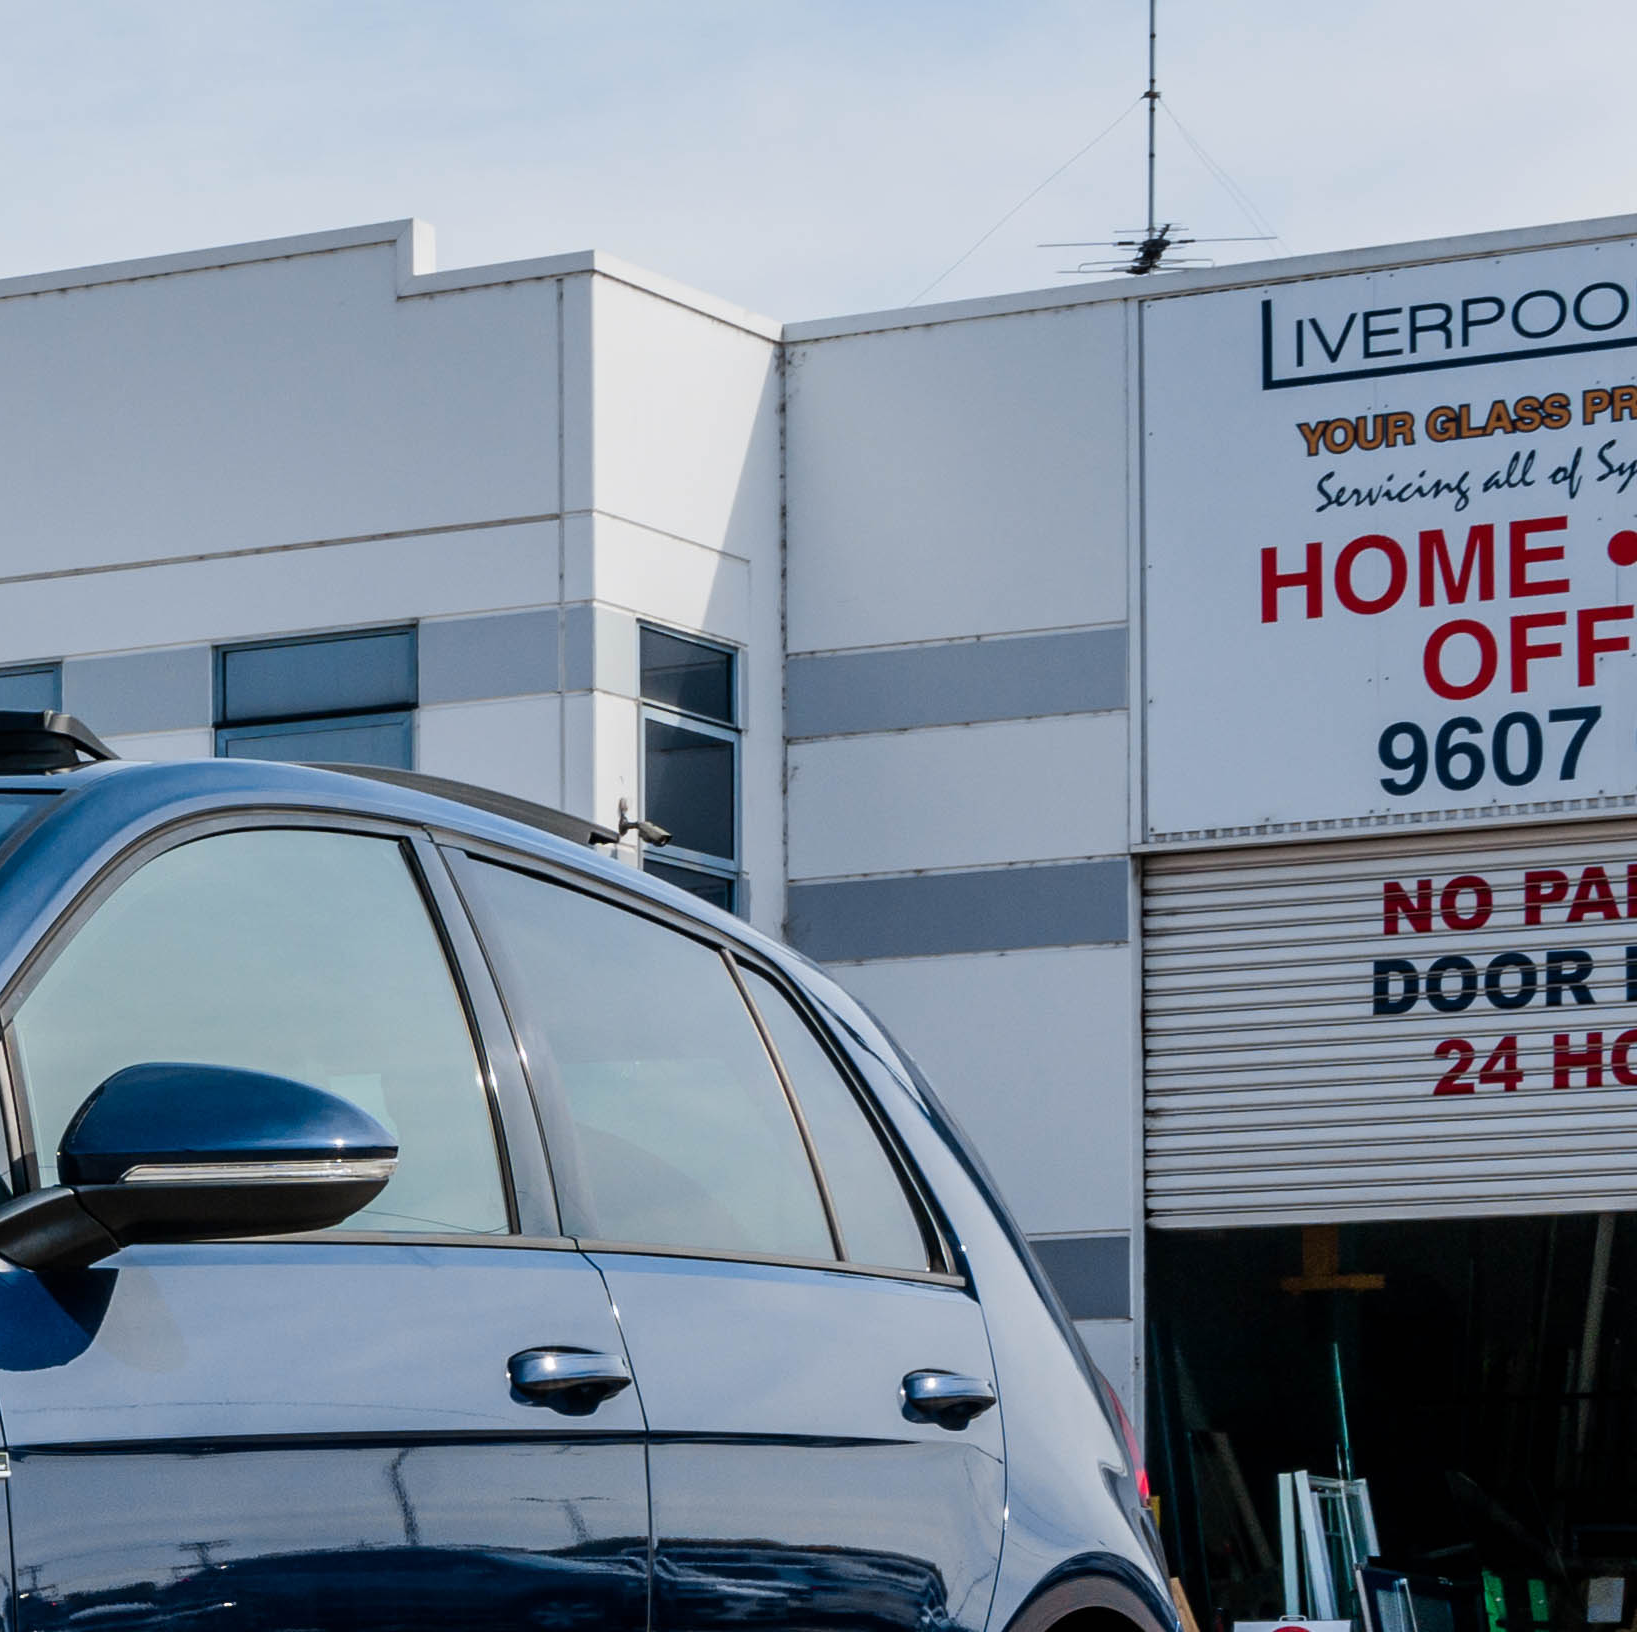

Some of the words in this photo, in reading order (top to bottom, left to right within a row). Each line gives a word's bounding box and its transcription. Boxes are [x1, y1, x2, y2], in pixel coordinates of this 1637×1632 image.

[1261, 281, 1637, 391] LIVERPOO
[1295, 411, 1415, 457] YOUR
[1424, 392, 1572, 442] GLASS
[1315, 471, 1470, 512] Servicing
[1482, 449, 1536, 494] all
[1548, 446, 1583, 500] of
[1260, 515, 1571, 624] HOME
[1422, 604, 1635, 701] OFF
[1377, 704, 1603, 797] 9607
[1382, 873, 1494, 935] NO
[1524, 864, 1637, 926] PA
[1372, 949, 1597, 1016] DOOR
[1432, 1034, 1524, 1096] 24
